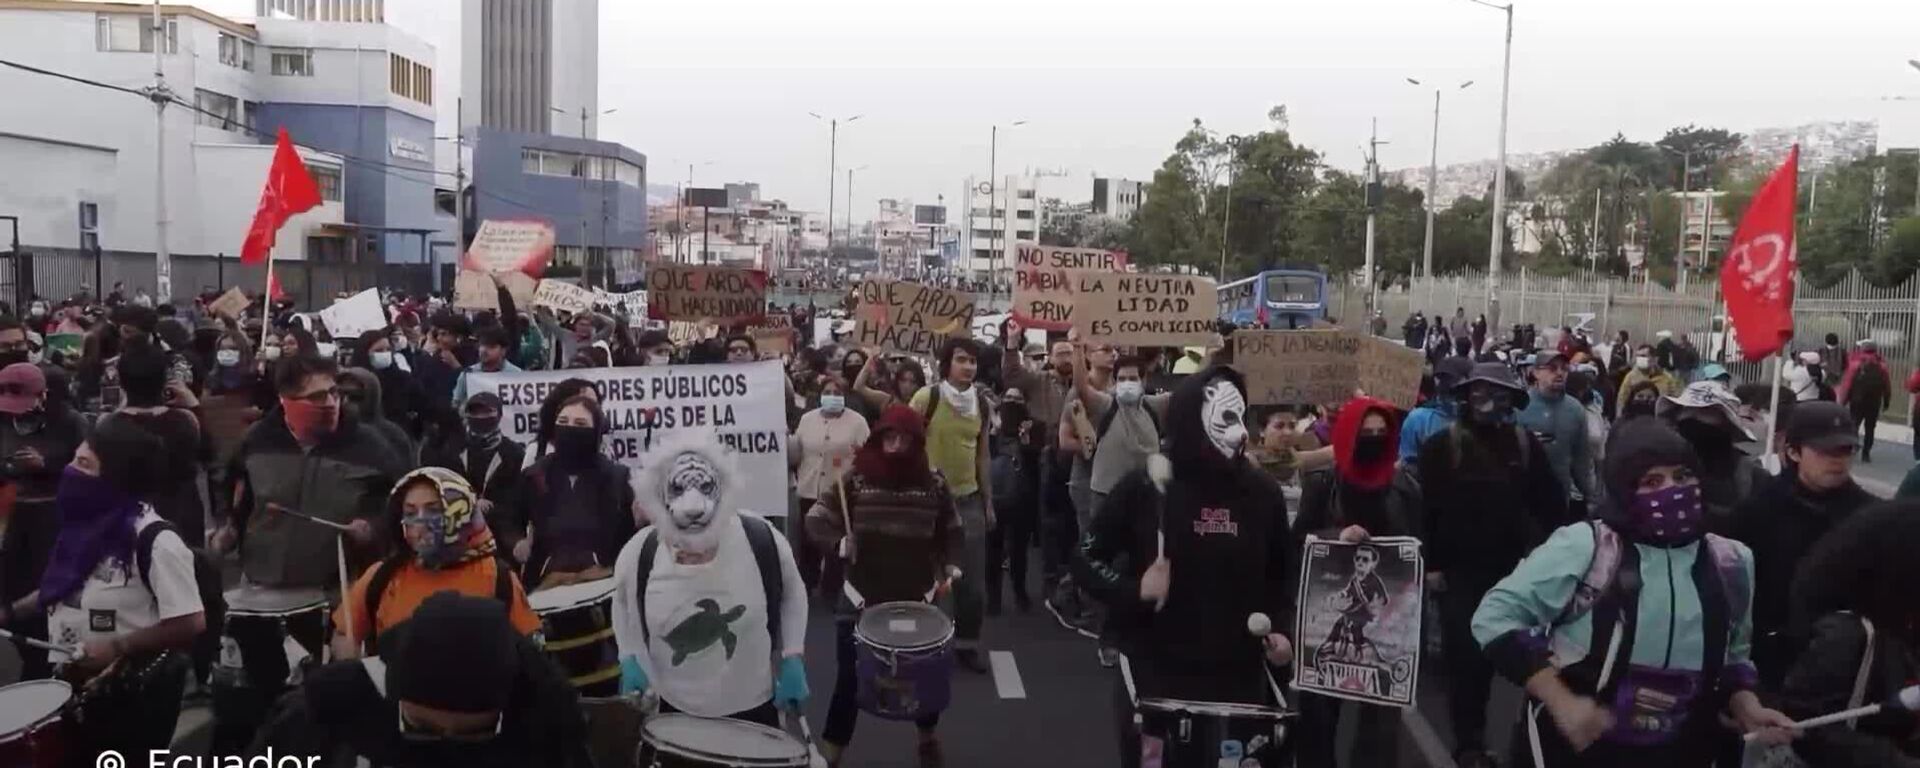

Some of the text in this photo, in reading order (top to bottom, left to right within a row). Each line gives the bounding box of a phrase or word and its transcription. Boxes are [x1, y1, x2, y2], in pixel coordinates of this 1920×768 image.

[1018, 249, 1115, 270] NO SENTIR
[652, 268, 760, 294] QUE ARDA
[1080, 278, 1195, 296] LA NEUTRA
[863, 279, 974, 329] QUE ARDA
[1030, 301, 1073, 321] PRIV
[1117, 297, 1189, 313] LIDAD
[895, 307, 923, 329] LA
[1091, 319, 1113, 335] ES
[860, 321, 949, 353] HACIEN
[1237, 334, 1276, 357] POR
[651, 369, 747, 399] PÚBLICOS
[681, 405, 706, 428] DE
[713, 403, 736, 426] LA
[613, 437, 638, 460] DE
